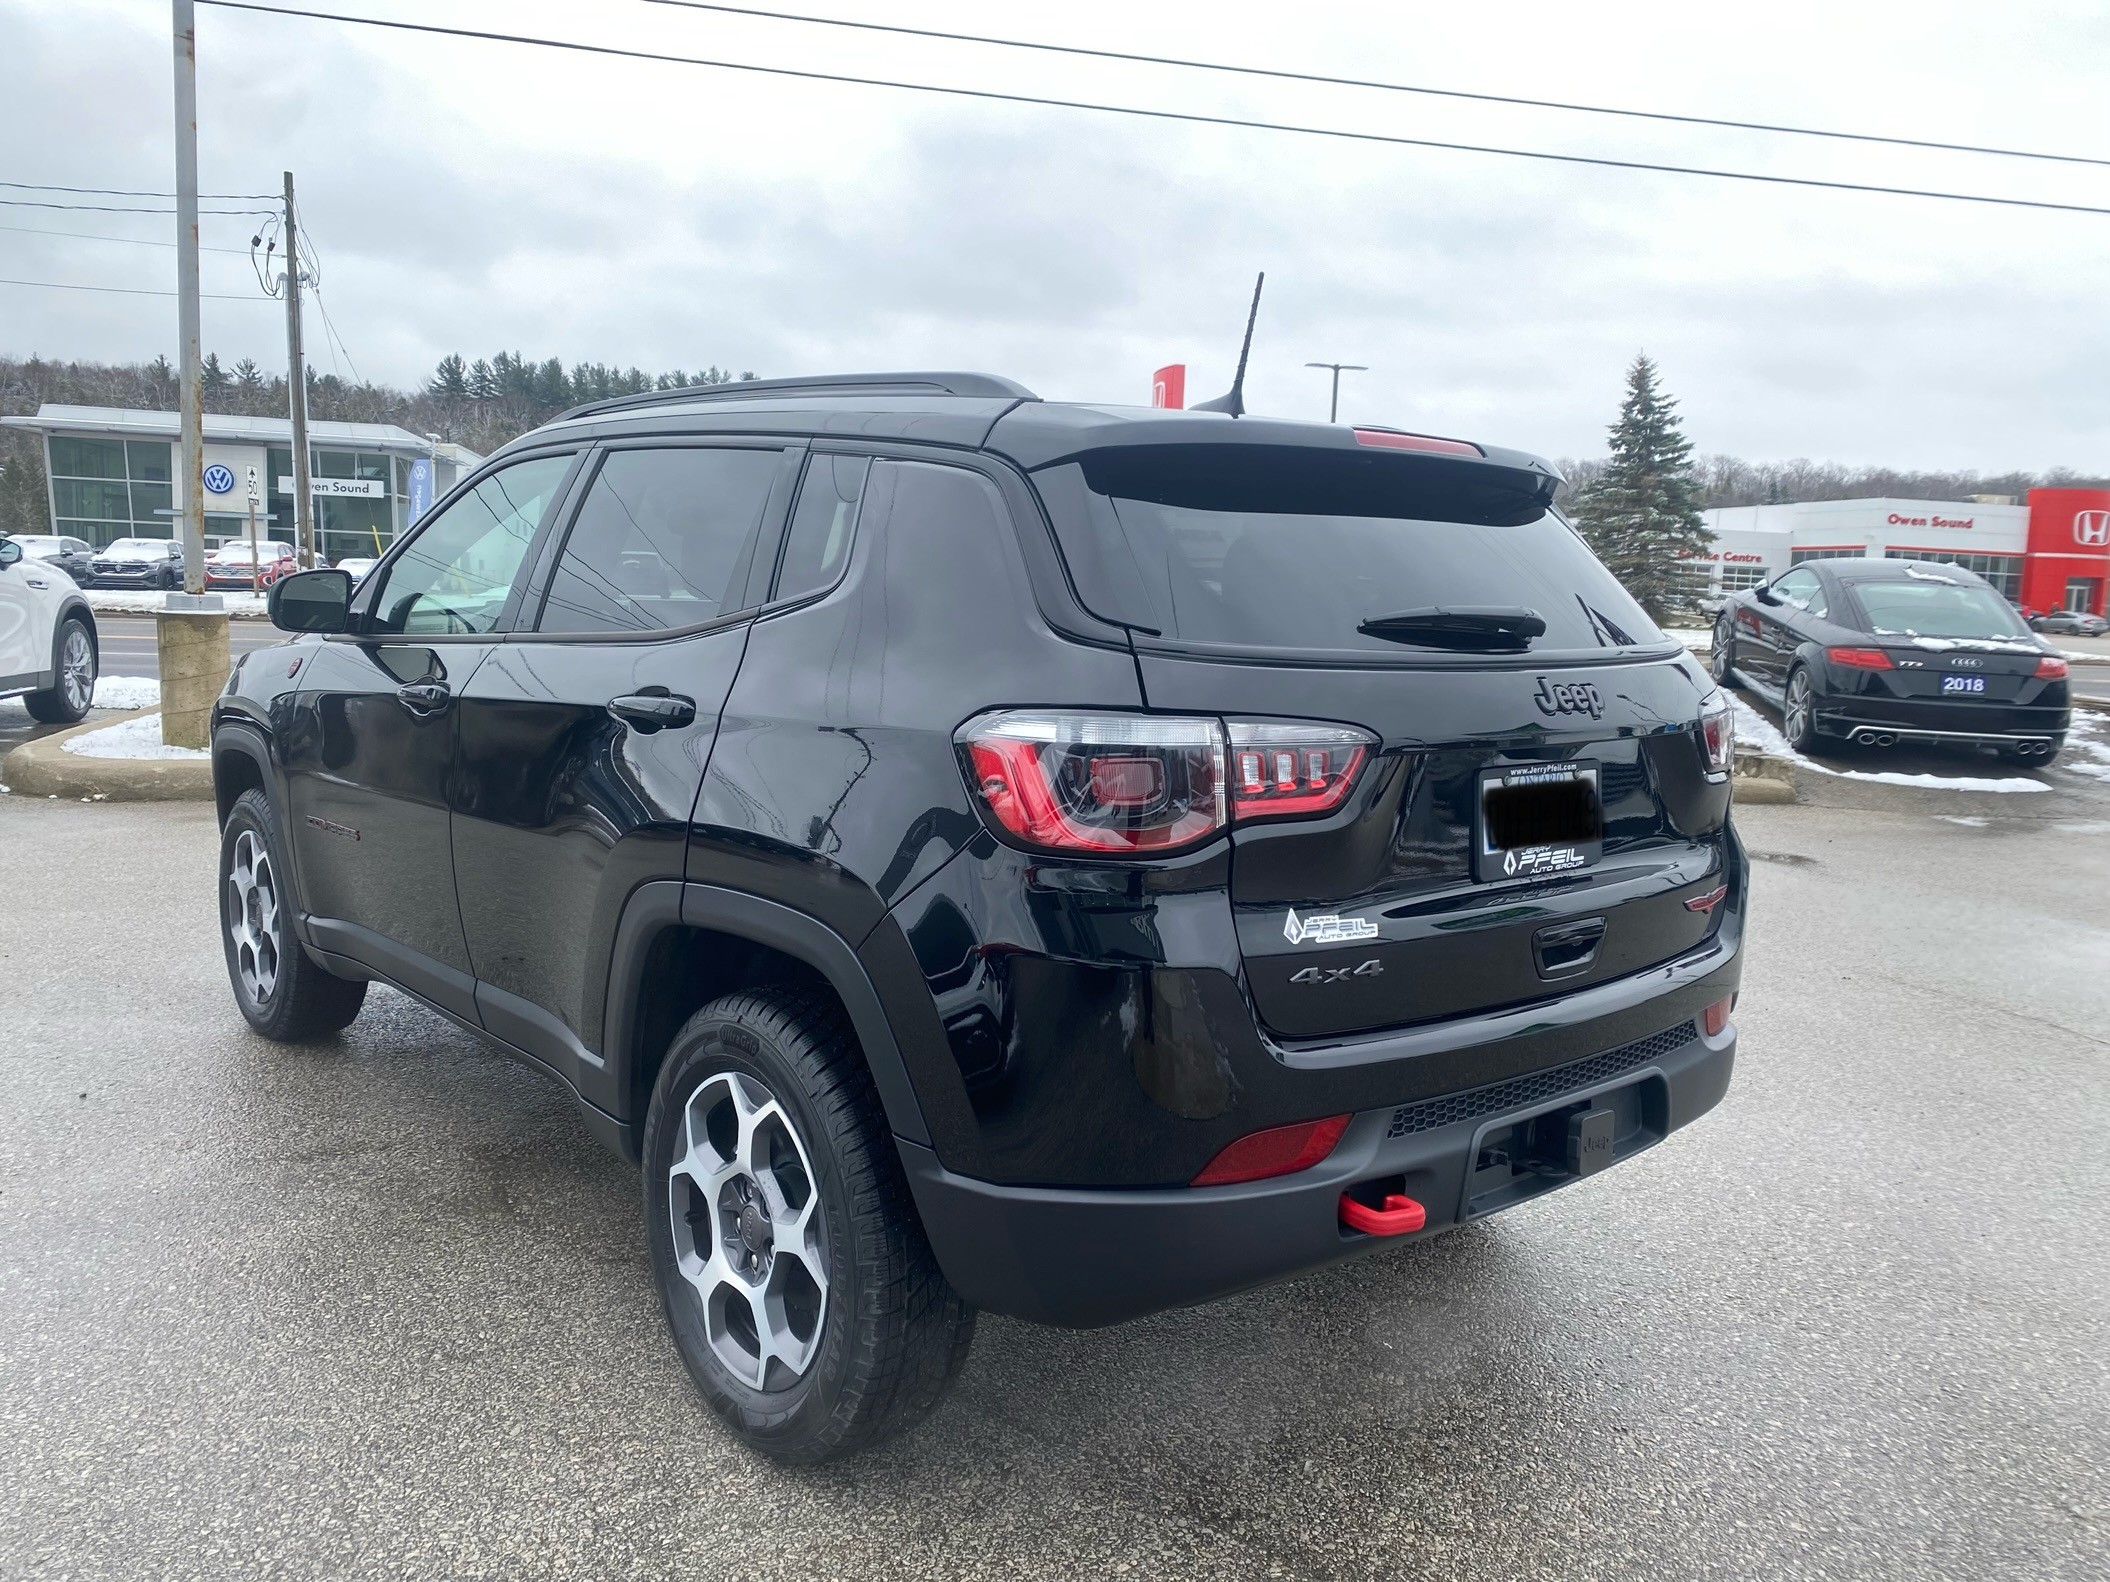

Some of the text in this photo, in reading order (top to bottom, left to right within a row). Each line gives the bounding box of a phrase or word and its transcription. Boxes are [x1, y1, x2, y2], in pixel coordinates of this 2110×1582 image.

[248, 480, 257, 496] 50
[292, 482, 369, 494] en Sound
[1888, 513, 1974, 529] Owen Sound
[1723, 551, 1762, 563] Centre
[1944, 677, 1984, 692] 2018
[1534, 676, 1605, 720] Jeep
[1510, 764, 1577, 776] www.JerryPfeil.com
[1521, 845, 1551, 855] JERRY
[1518, 848, 1584, 870] PFEIL
[1530, 861, 1584, 874] AUTO GROUP
[1305, 921, 1375, 936] PFEIL
[1584, 1136, 1609, 1152] Jeep
